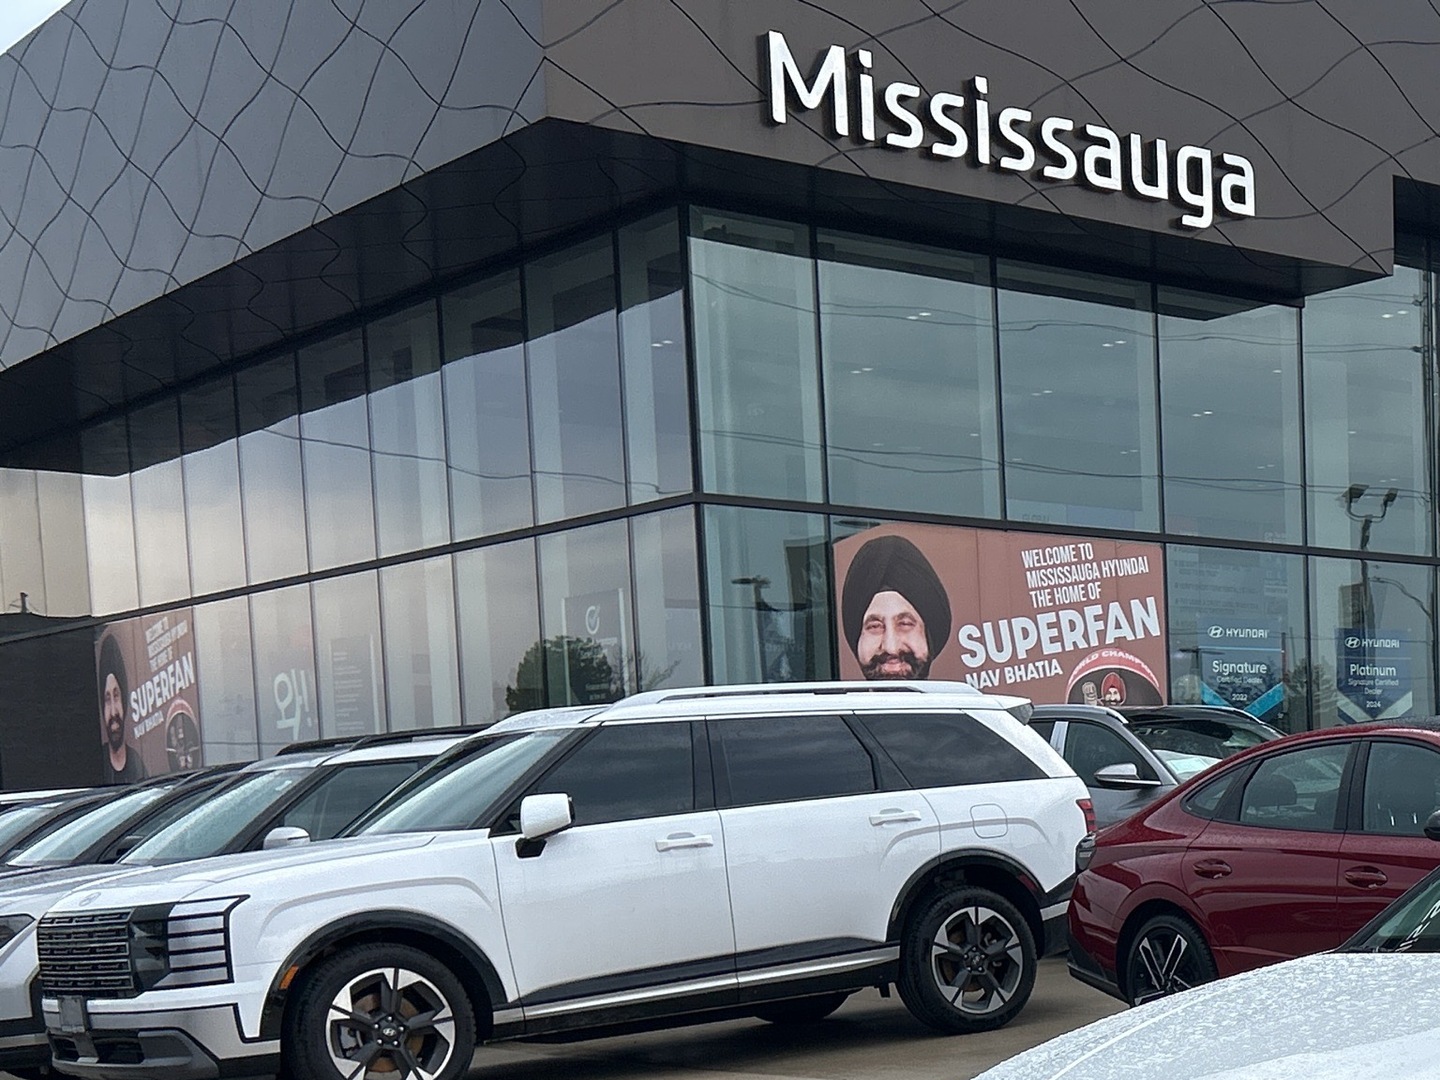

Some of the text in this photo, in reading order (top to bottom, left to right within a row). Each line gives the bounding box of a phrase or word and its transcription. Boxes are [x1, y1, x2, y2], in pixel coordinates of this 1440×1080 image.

[767, 29, 1257, 228] Mississauga
[1021, 543, 1094, 568] WELCOME TO
[1026, 556, 1149, 589] MISSISSAUGA HYUNDAI
[1029, 582, 1102, 608] THE HOME OF
[958, 597, 1161, 669] SUPERFAN
[1226, 628, 1268, 638] HYUNDAI
[1362, 639, 1400, 648] HYUNDAI
[965, 658, 1063, 690] NAV BHATIA
[1212, 660, 1267, 675] Signature
[1350, 664, 1396, 676] Platinum
[130, 652, 195, 722] SUPERFAN
[1348, 678, 1399, 687] Signature Certified
[1364, 687, 1383, 695] Dealer
[1366, 700, 1381, 708] 2024
